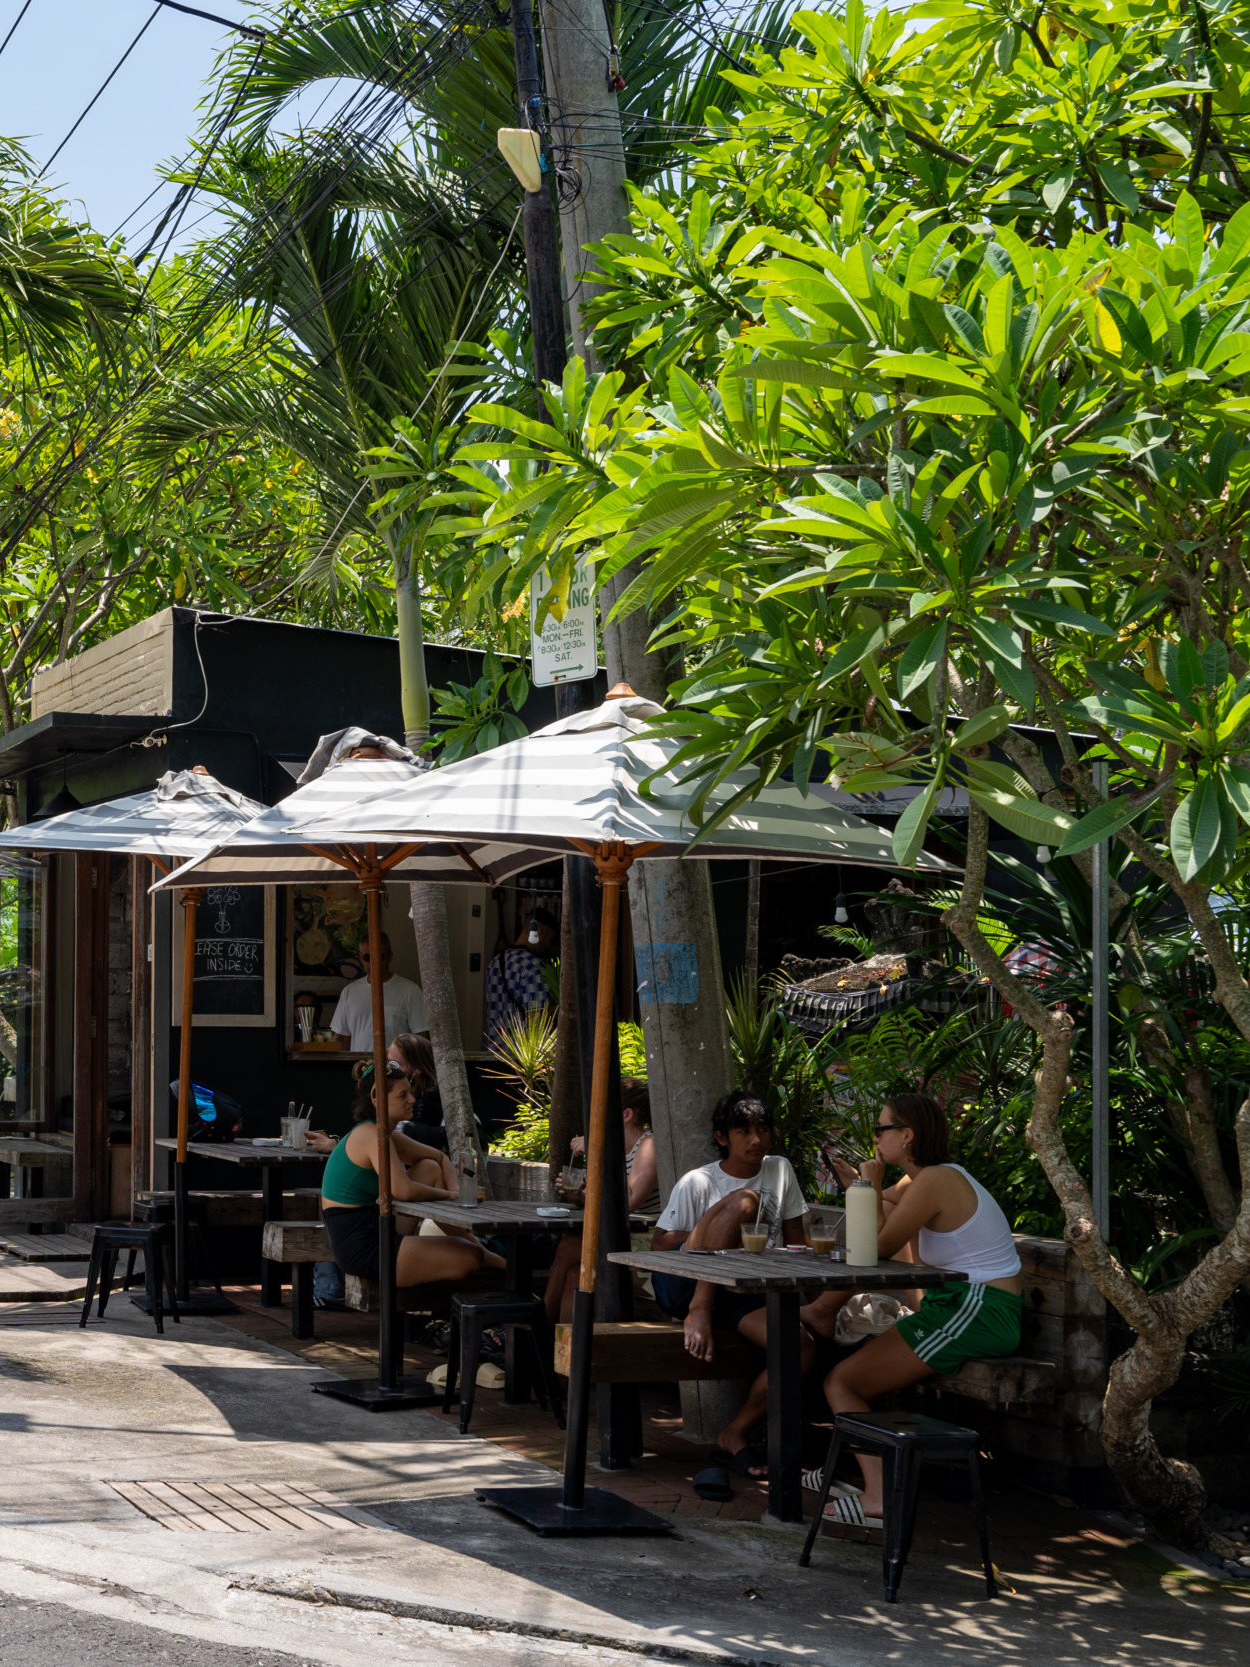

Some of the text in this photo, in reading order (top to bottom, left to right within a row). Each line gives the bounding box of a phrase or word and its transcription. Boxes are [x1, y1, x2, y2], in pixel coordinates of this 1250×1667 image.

[537, 571, 543, 591] 1
[555, 651, 573, 662] SAT.
[228, 943, 258, 962] ORDER
[207, 958, 242, 971] INSIDE
